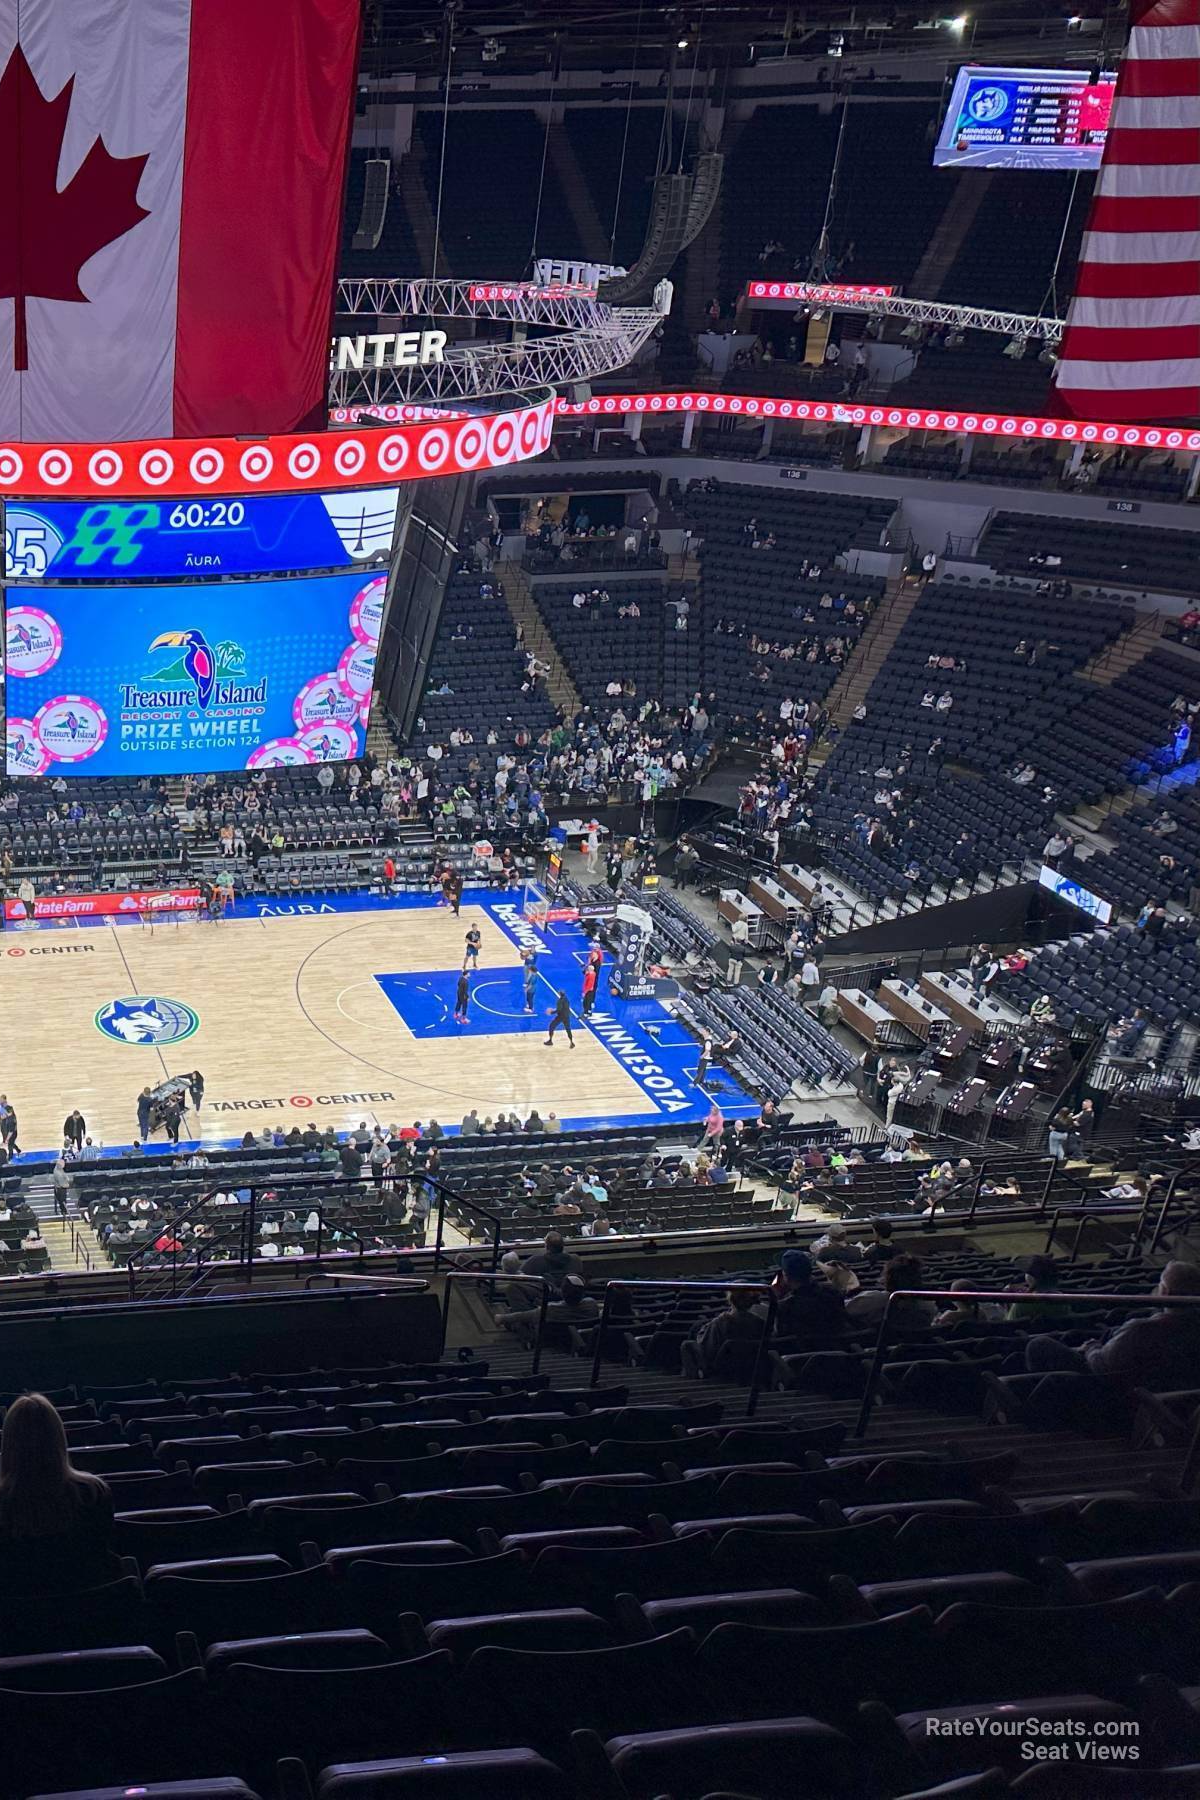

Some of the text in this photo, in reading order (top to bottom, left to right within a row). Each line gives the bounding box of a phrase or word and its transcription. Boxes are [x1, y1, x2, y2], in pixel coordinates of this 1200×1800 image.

[958, 134, 1004, 142] TIMBERWOLVES
[330, 330, 447, 371] NTER
[169, 502, 245, 528] 60:20
[119, 676, 267, 710] Treasure Island
[120, 706, 265, 721] RESORT & CASINO
[43, 728, 97, 739] Treasure Island
[121, 718, 261, 739] PRIZE WHEEL
[120, 735, 260, 752] OUTSIDE SECTION 124
[29, 944, 95, 956] CENTER
[587, 1012, 694, 1113] MINNESOTA
[209, 1092, 396, 1112] TARGET CENTER
